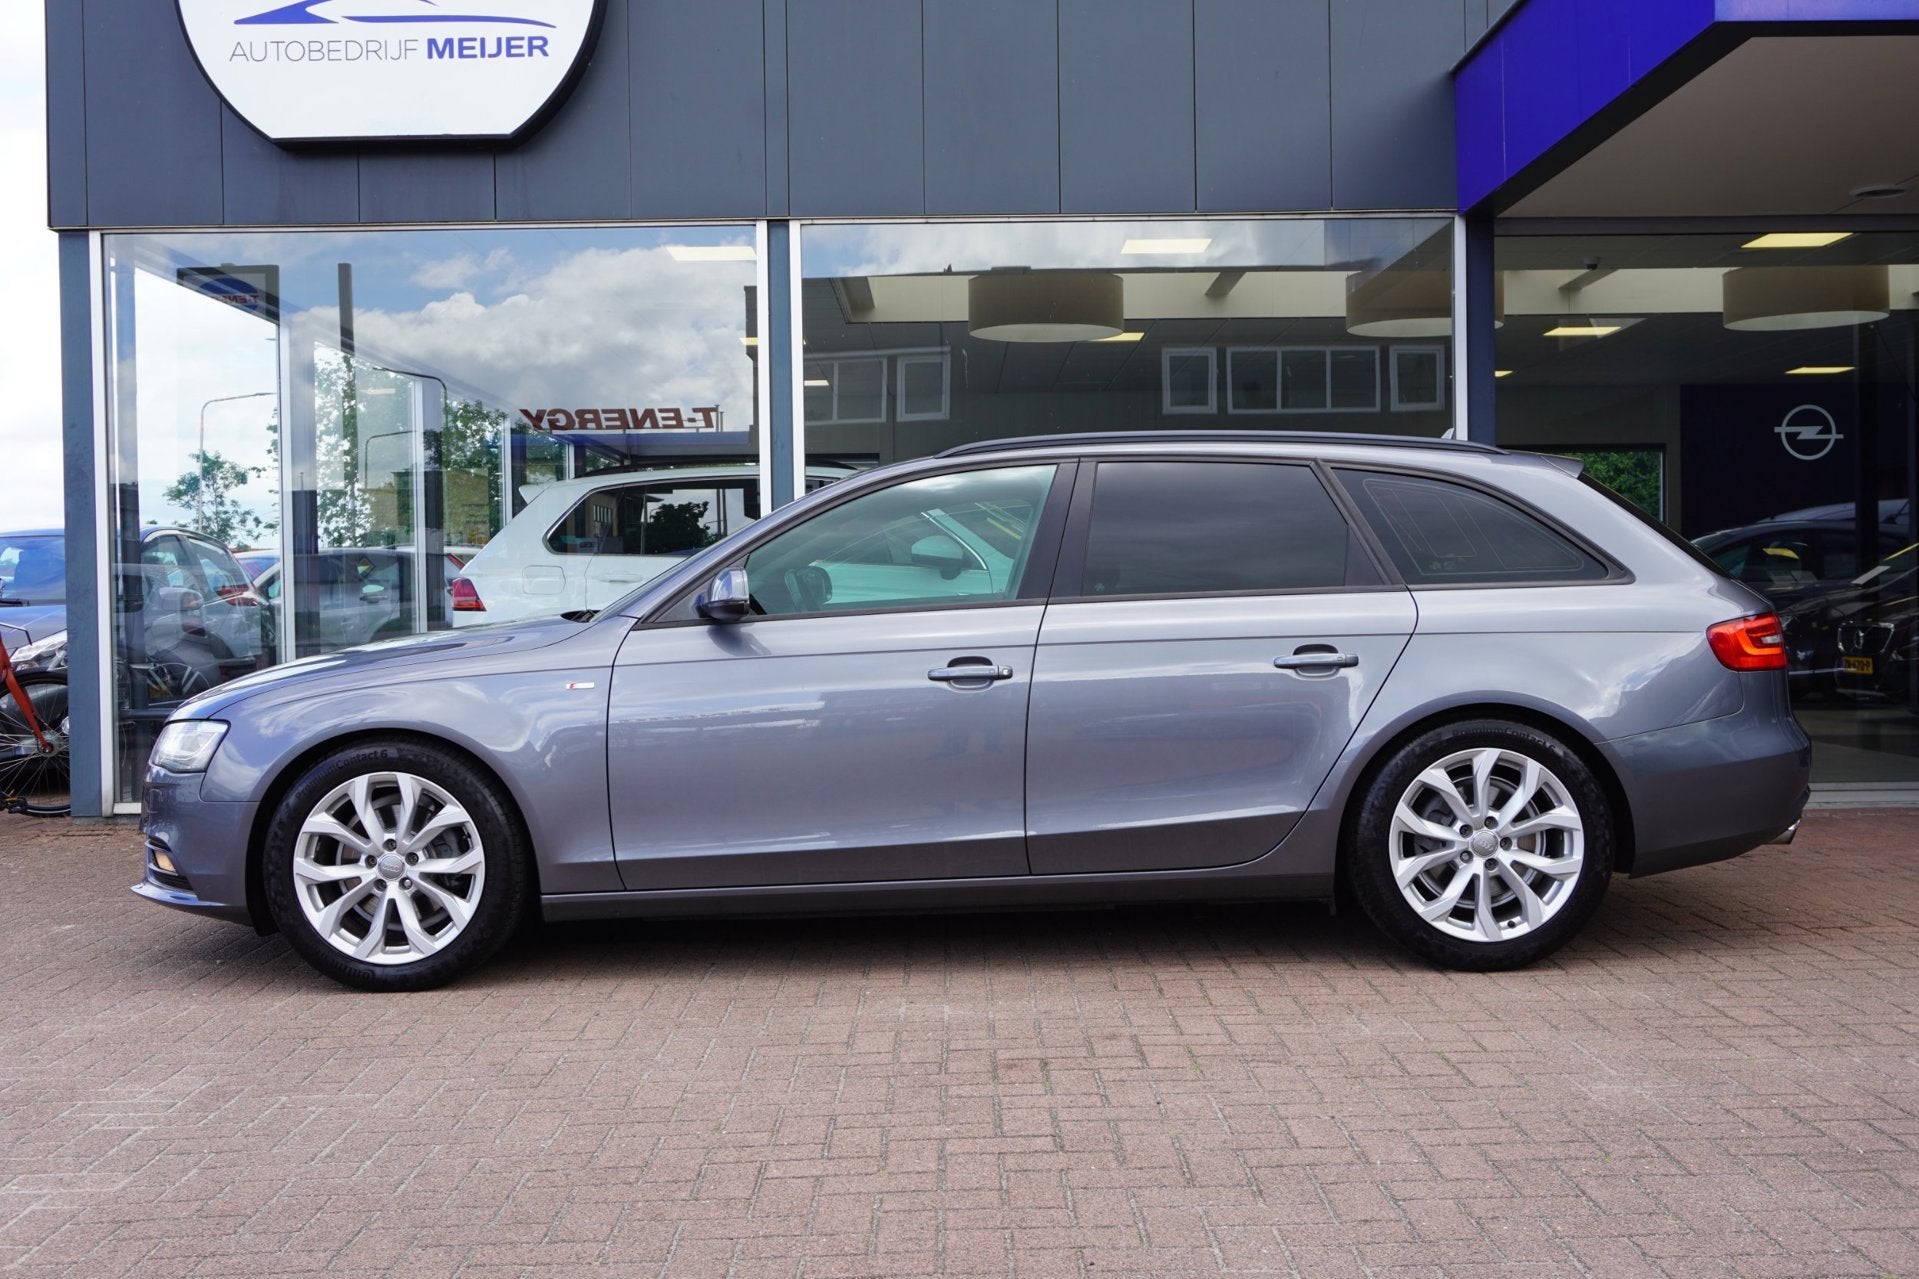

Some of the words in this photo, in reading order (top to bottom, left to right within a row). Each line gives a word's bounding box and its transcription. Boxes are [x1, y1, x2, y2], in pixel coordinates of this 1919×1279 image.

[229, 39, 419, 62] AUTOBEDRIJF
[427, 35, 550, 60] MEIJER
[380, 749, 389, 759] 6
